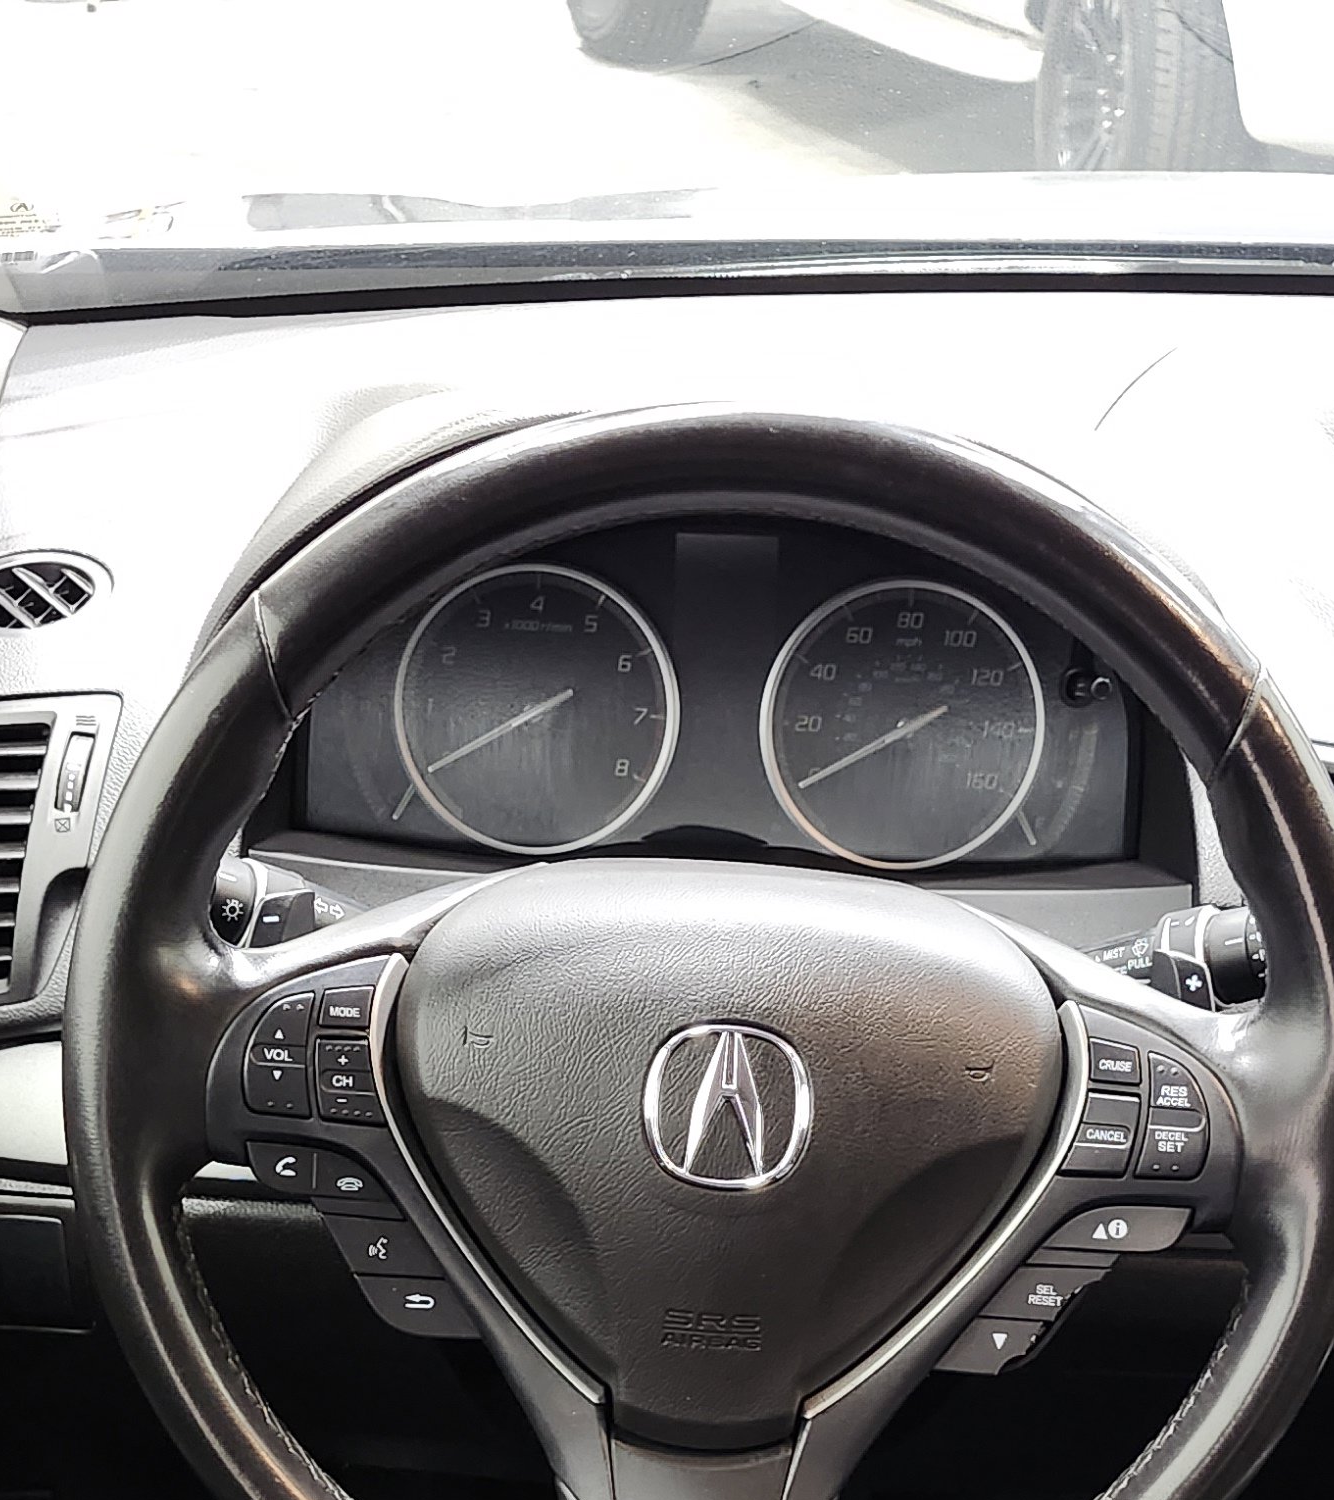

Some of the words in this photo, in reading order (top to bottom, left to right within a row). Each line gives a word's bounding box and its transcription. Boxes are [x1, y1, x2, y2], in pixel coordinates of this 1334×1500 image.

[530, 596, 544, 613] 4
[477, 610, 491, 627] 3
[583, 615, 598, 632] 5
[897, 612, 924, 629] 80
[846, 627, 873, 644] 60
[944, 630, 977, 648] 100
[618, 655, 632, 672] 6
[810, 664, 837, 681] 40
[971, 668, 1004, 686] 120
[633, 707, 648, 725] 7
[795, 715, 823, 732] 20
[614, 759, 629, 776] 8
[966, 773, 998, 790] 160
[1102, 947, 1126, 962] MIST
[1127, 956, 1153, 971] PULL
[329, 1006, 361, 1018] MODE
[264, 1047, 293, 1062] VOL
[1098, 1058, 1133, 1073] CRUISE
[332, 1074, 354, 1088] CH
[1160, 1085, 1188, 1097] RES
[1156, 1096, 1191, 1108] ACCEL
[1086, 1128, 1127, 1143] CANCEL
[1154, 1130, 1188, 1141] DECEL
[1157, 1140, 1185, 1153] SET
[1036, 1284, 1057, 1296] SEL
[1027, 1294, 1064, 1307] RESET
[663, 1311, 761, 1332] SRS
[662, 1335, 761, 1351] AIRBAG
